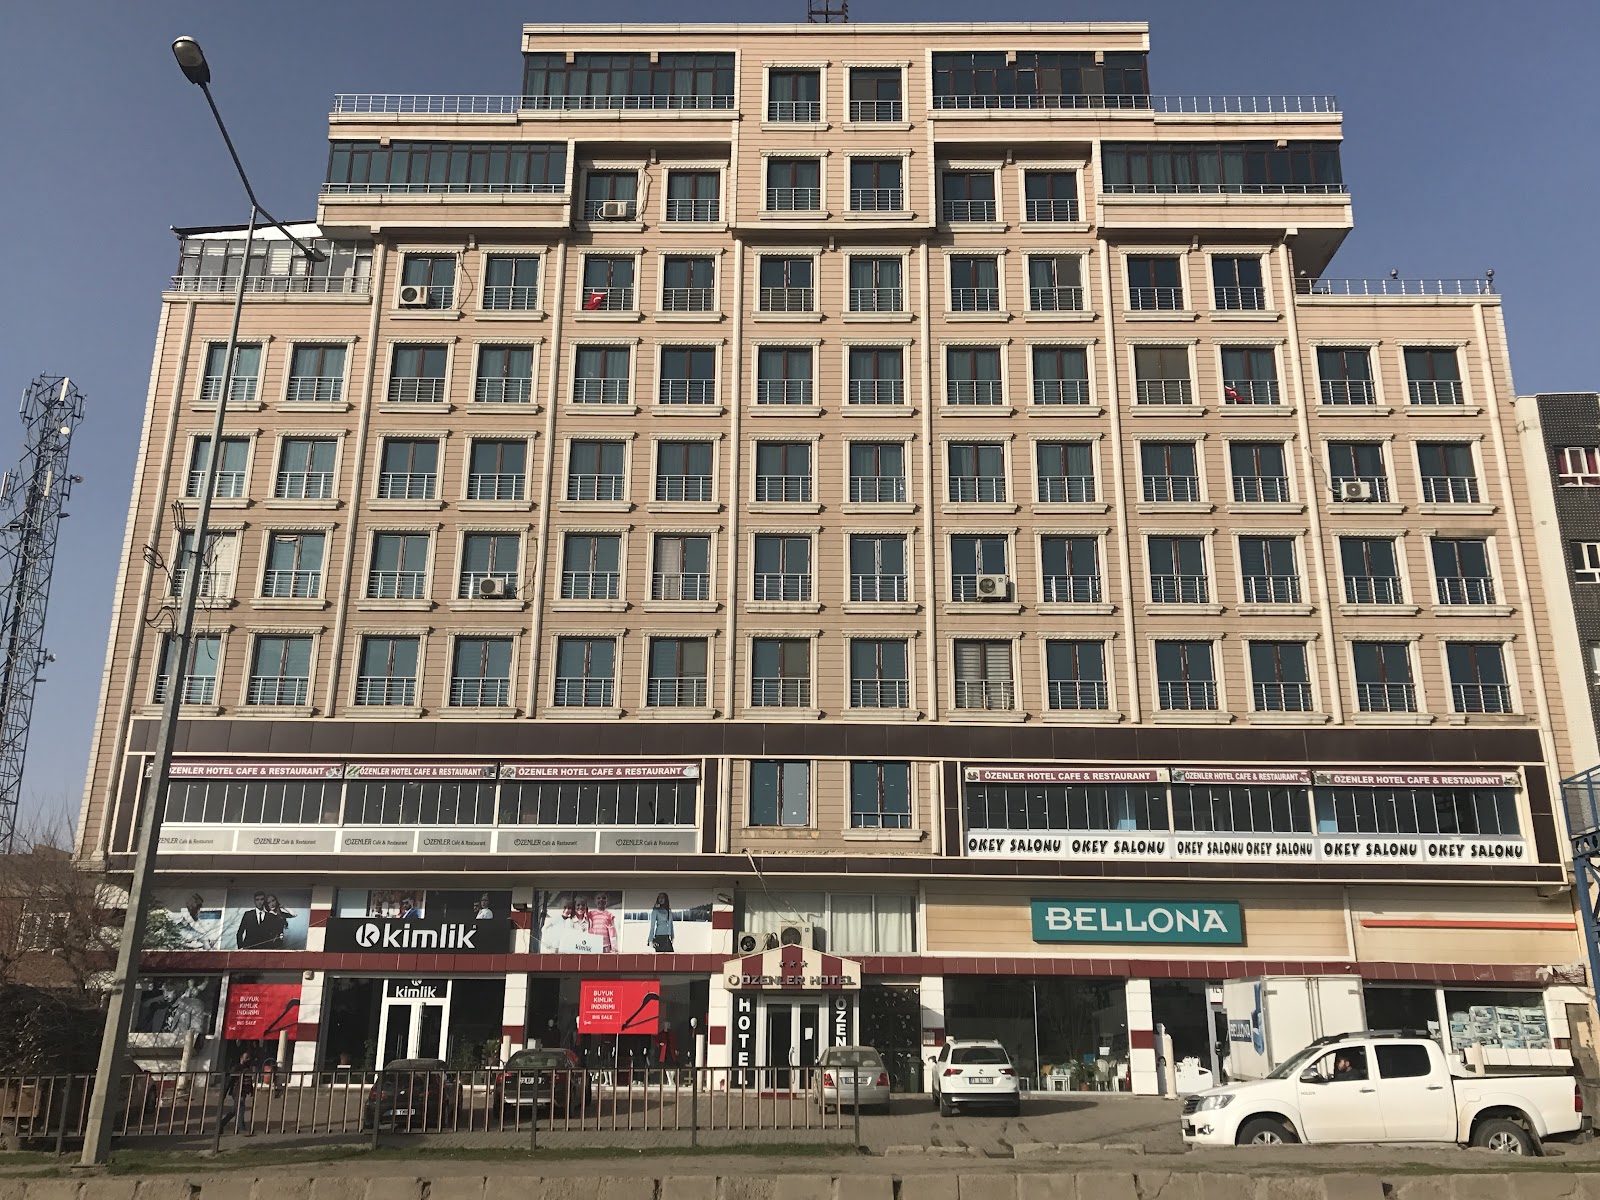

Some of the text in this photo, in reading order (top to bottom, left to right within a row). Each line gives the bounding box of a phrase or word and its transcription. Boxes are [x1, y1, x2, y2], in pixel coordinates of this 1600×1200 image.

[168, 767, 325, 775] ZENLER HOTEL CAFE & RESTAURANT
[359, 767, 390, 775] ÖZENLER
[413, 768, 431, 776] CAFE
[432, 768, 437, 776] &
[438, 768, 482, 776] RESTAURANT
[518, 766, 682, 776] ÖZENLER HOTEL CAFE & RESTAURANT
[984, 770, 1151, 780] ÖZENLER HOTEL CAFE & RESTAURANT
[1184, 771, 1213, 780] ÖZENLER
[1214, 772, 1234, 780] HOTEL
[1253, 773, 1258, 781] &
[1259, 773, 1298, 781] RESTAURANT
[1334, 775, 1500, 785] ÖZENLER HOTEL CAFE & RESTAURANT
[968, 838, 1062, 852] OKEY SALONU
[1071, 839, 1165, 854] OKEY SALONU
[1177, 841, 1244, 855] OKEY SALONU
[1246, 842, 1313, 855] OKEY SALONU
[1324, 843, 1417, 857] OKEY SALONU
[1428, 844, 1523, 858] OKEY SALONU
[1045, 907, 1228, 933] BELLONA
[382, 923, 478, 949] kimlik
[741, 972, 806, 986] ÖZENLER
[809, 975, 857, 986] HOTEL
[395, 985, 437, 998] kimlik
[835, 995, 847, 1047] ÖZEN
[738, 997, 751, 1085] HOTEL
